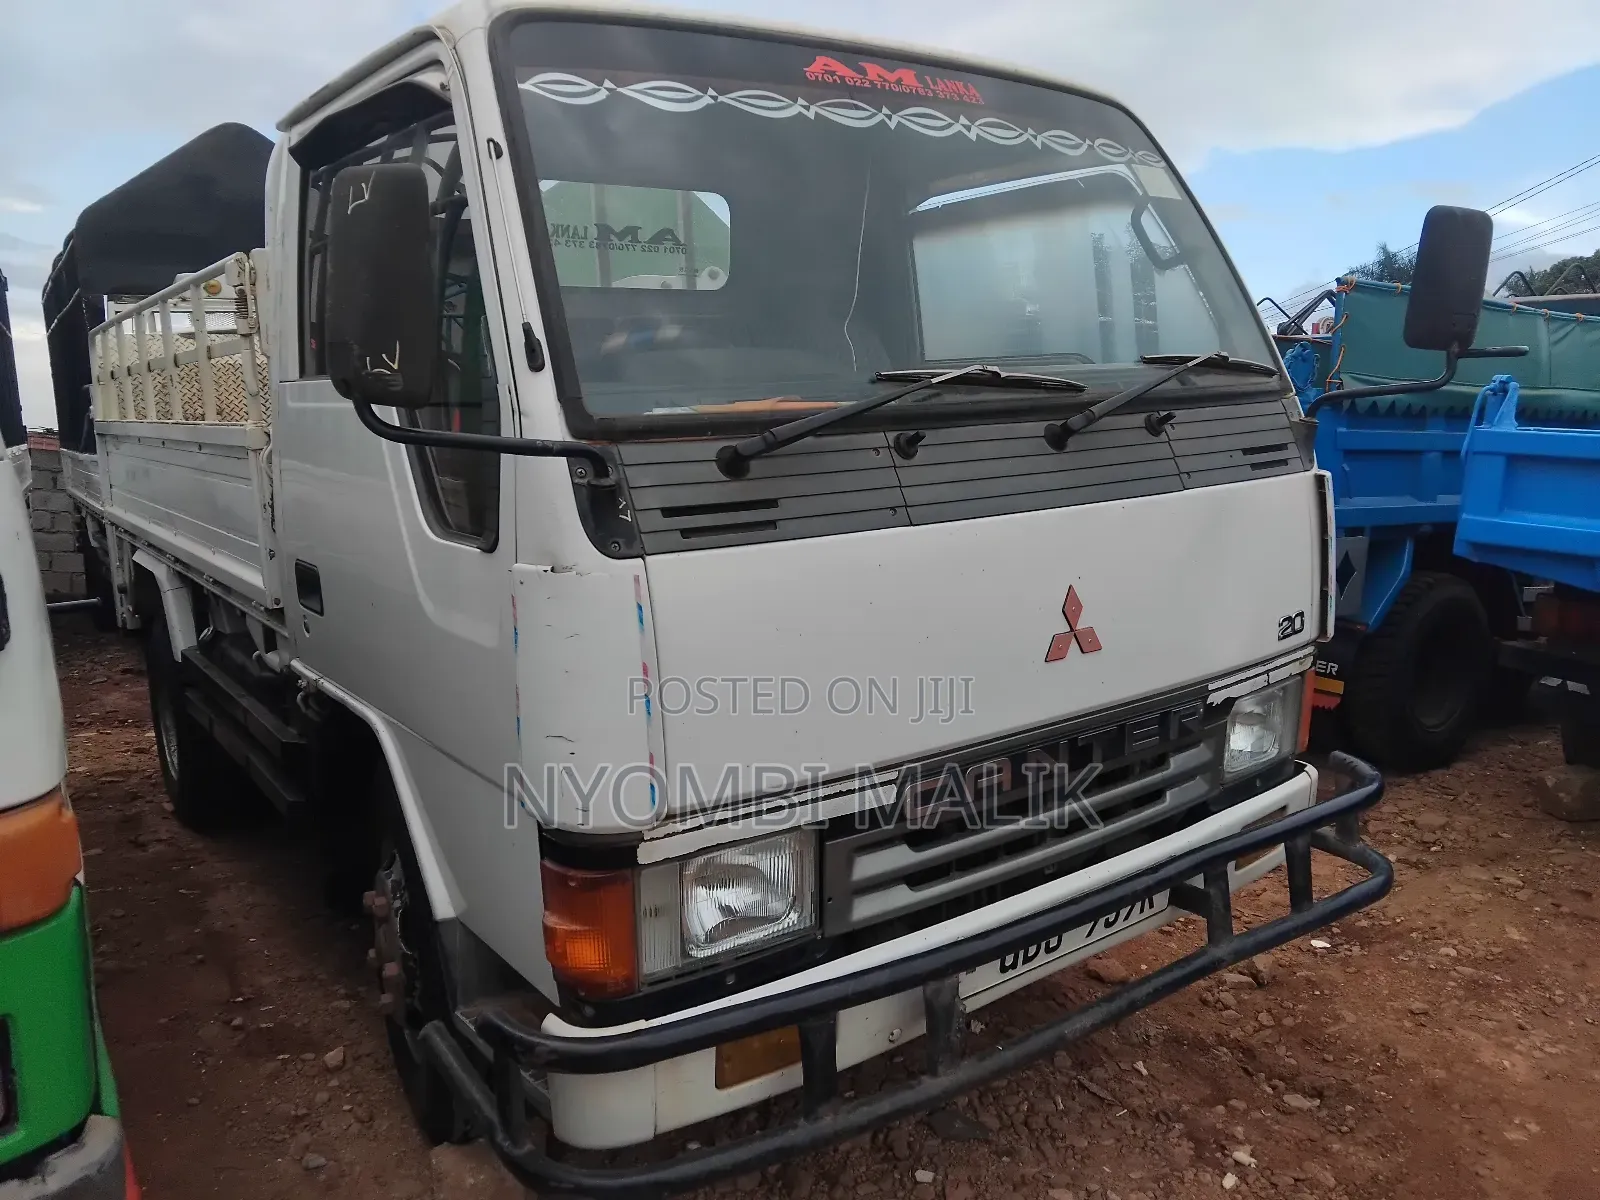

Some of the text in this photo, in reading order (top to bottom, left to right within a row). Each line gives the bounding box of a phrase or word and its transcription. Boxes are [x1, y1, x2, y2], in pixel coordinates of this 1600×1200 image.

[803, 55, 981, 98] AM LANKA
[805, 71, 841, 84] 0701
[845, 76, 871, 88] 022
[1278, 610, 1305, 641] 20
